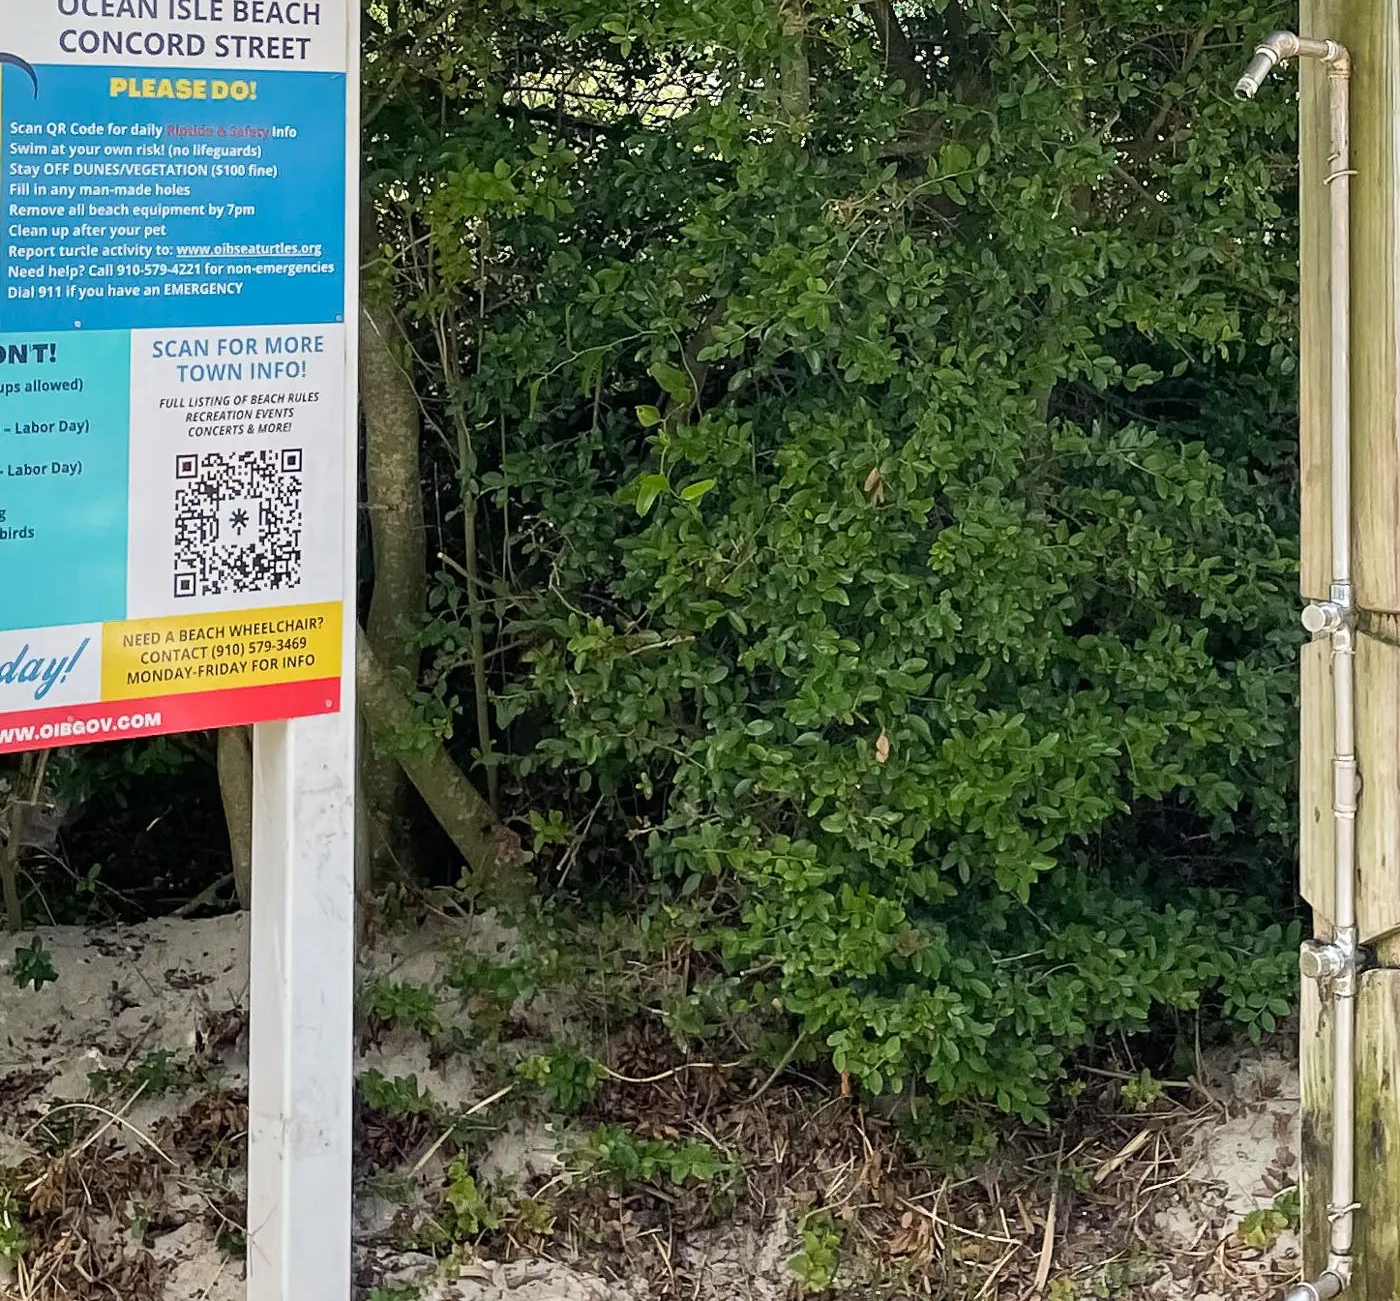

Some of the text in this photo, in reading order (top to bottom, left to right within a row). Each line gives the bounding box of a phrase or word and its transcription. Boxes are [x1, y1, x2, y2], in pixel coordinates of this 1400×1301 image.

[233, 0, 320, 25] BEACH
[59, 29, 311, 60] CONCORD STREET
[109, 77, 257, 100] PLEASE DO!
[10, 122, 42, 134] Scan
[46, 123, 66, 136] QR
[70, 123, 103, 135] Code
[107, 123, 127, 135] for
[131, 123, 163, 138] daily
[216, 125, 226, 136] &
[272, 126, 297, 137] Info
[10, 143, 262, 159] Swim at your own risk! (no lifeguards)
[9, 163, 278, 178] Stay OFF DUNES/VEGETATION ($100 fine)
[10, 184, 191, 199] Fill in any man-made holes
[9, 204, 255, 219] Remove all beach equipment by 7pm
[8, 224, 166, 239] Clean up after your pet
[8, 243, 322, 260] Report turtle activity to: www.oibseaturtles.org
[8, 262, 335, 280] Need help? Call 910-579-4221 for non-emergencies
[8, 282, 243, 300] Dial 911 if you have an EMERGENCY
[152, 336, 323, 358] SCAN FOR MORE
[176, 361, 306, 382] TOWN INFO!
[25, 379, 83, 392] allowed)
[159, 392, 319, 408] FULL LISTING OF BEACH RULES
[185, 408, 294, 422] RECREATION EVENTS
[15, 421, 56, 434] Labor
[59, 420, 89, 435] Day)
[188, 422, 292, 437] CONCERTS & MORE!
[8, 464, 47, 476] Labor
[51, 461, 82, 475] Day)
[123, 616, 324, 647] NEED A BEACH WHEELCHAIR?
[141, 637, 307, 664] CONTACT (910) 579-3469
[0, 637, 90, 700] day!
[127, 654, 315, 685] MONDAY-FRIDAY FOR INFO
